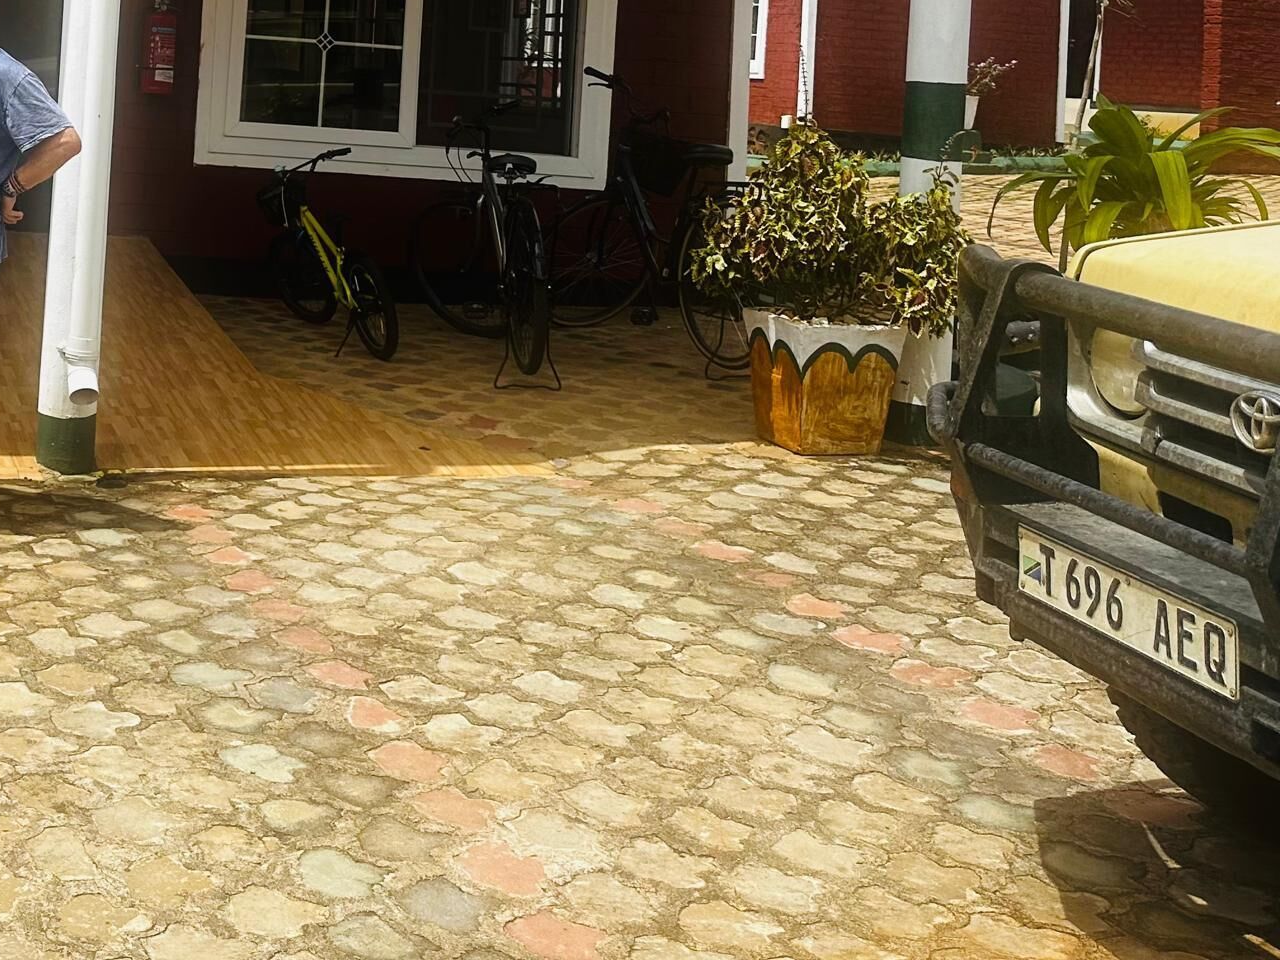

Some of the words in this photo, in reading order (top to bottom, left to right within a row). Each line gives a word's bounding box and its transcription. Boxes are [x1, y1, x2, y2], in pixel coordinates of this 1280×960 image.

[1038, 543, 1056, 597] T
[1065, 558, 1124, 632] 696
[1152, 598, 1228, 688] AEQ
